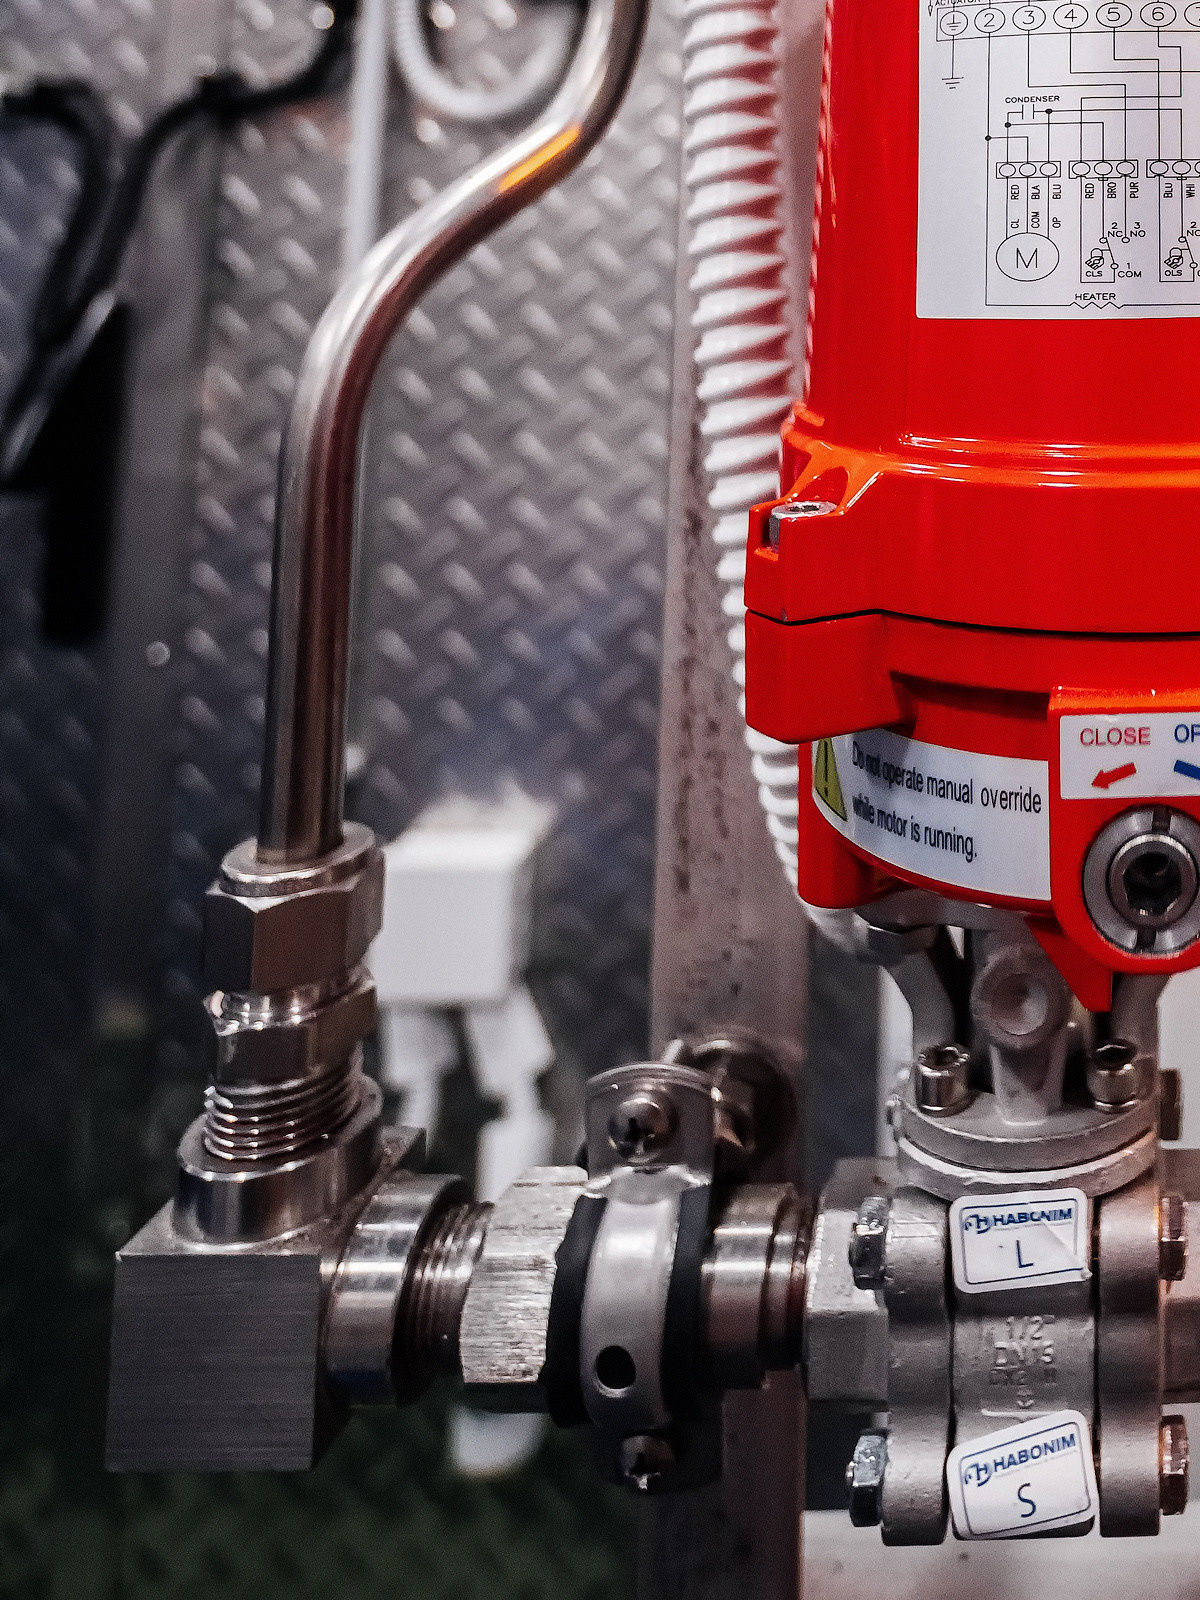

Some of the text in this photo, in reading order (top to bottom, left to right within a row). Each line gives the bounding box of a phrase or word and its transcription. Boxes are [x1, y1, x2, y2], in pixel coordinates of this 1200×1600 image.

[984, 13, 995, 27] 2
[1022, 11, 1035, 25] 3
[1064, 8, 1077, 22] 4
[1106, 7, 1120, 21] 5
[1152, 7, 1164, 21] 6
[1005, 95, 1060, 104] CONDENSER
[1011, 184, 1020, 200] RED
[1031, 185, 1040, 200] BLA
[1053, 184, 1061, 200] BLU
[1085, 183, 1094, 199] RED
[1107, 182, 1117, 198] BRO
[1130, 182, 1139, 198] PUR
[1164, 183, 1173, 198] BLU
[1186, 184, 1195, 198] WHI
[1011, 219, 1019, 229] CL
[1031, 211, 1040, 228] COM
[1052, 217, 1061, 228] OP
[1016, 247, 1038, 269] M
[1080, 727, 1151, 746] CLOSE
[852, 741, 1042, 814] Do not operate manual override
[852, 793, 978, 863] while motor is running.
[1016, 1240, 1034, 1268] L
[993, 1433, 1076, 1472] HABONIM
[1017, 1483, 1036, 1518] S
